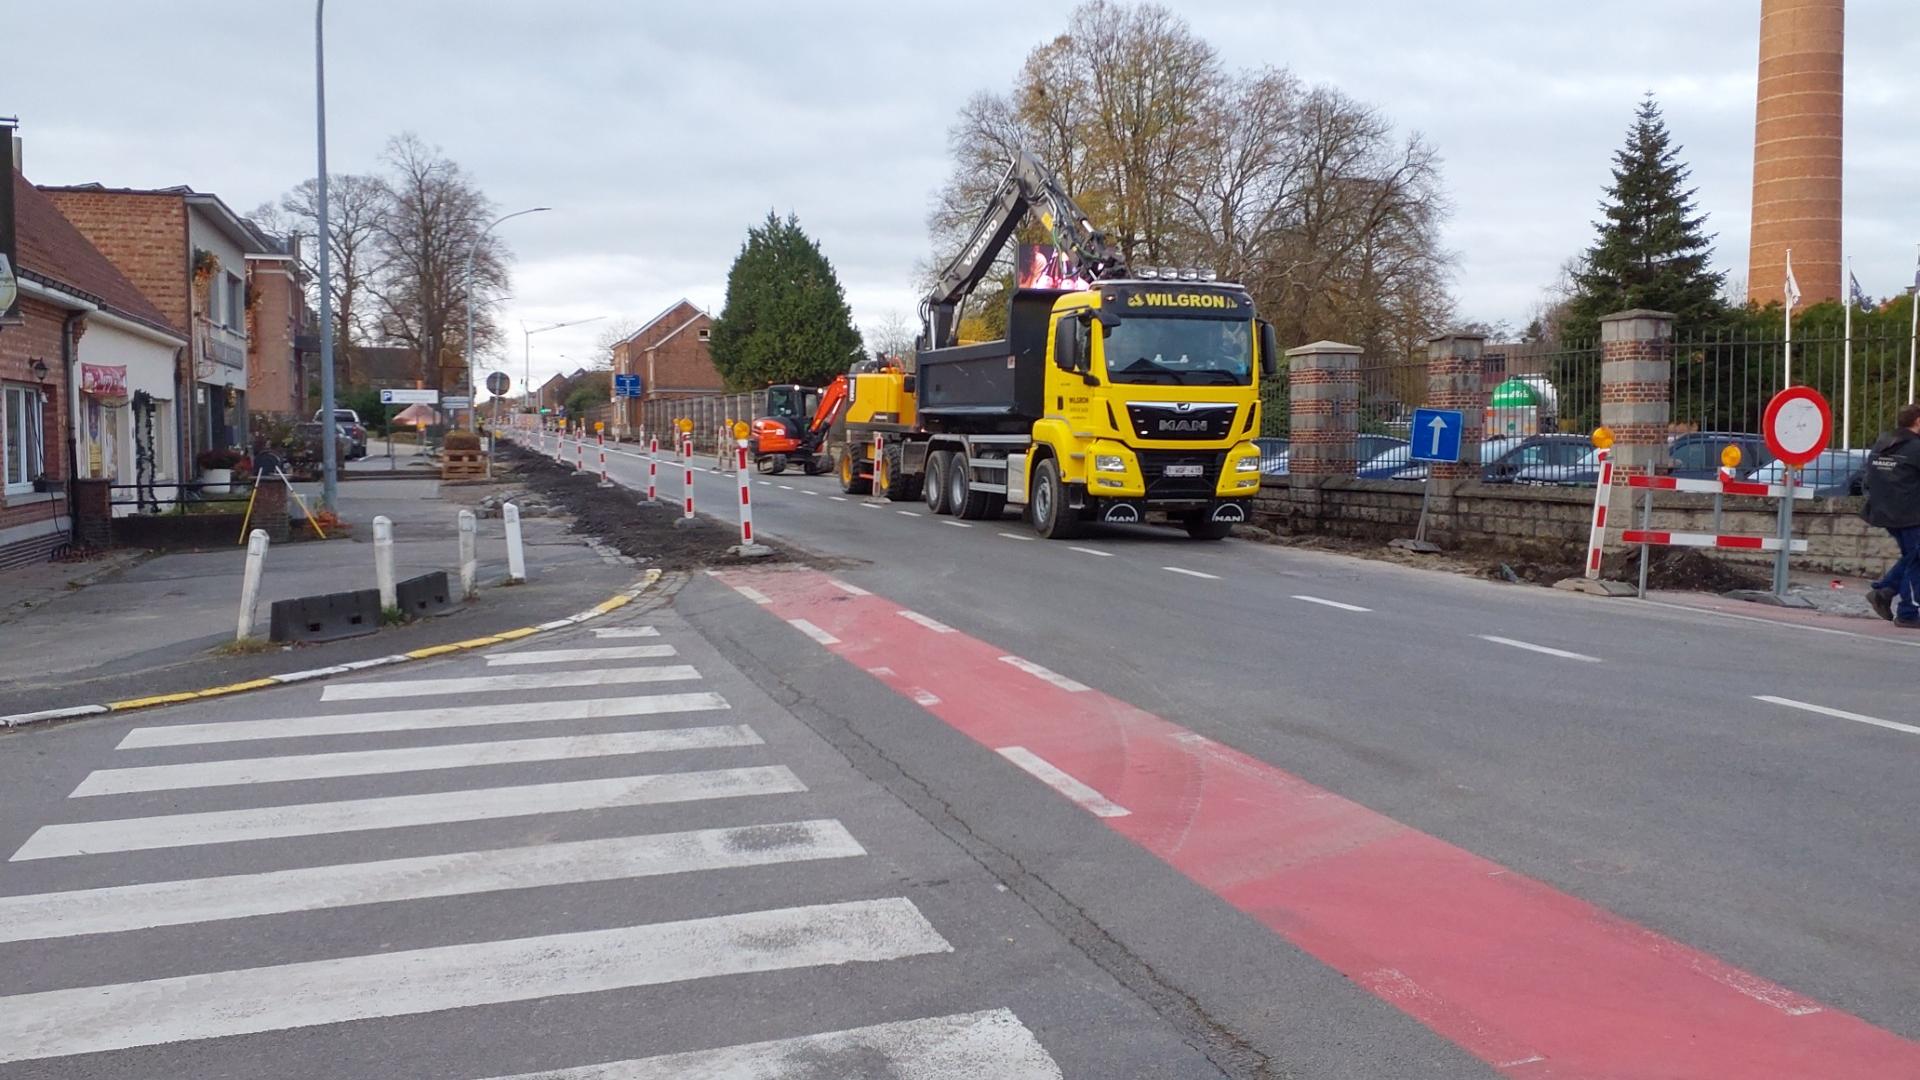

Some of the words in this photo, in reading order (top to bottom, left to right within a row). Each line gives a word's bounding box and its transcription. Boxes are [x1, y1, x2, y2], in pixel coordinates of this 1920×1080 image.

[963, 219, 998, 266] VOLVO
[1145, 293, 1224, 308] WILGRON
[1158, 419, 1208, 431] MAN
